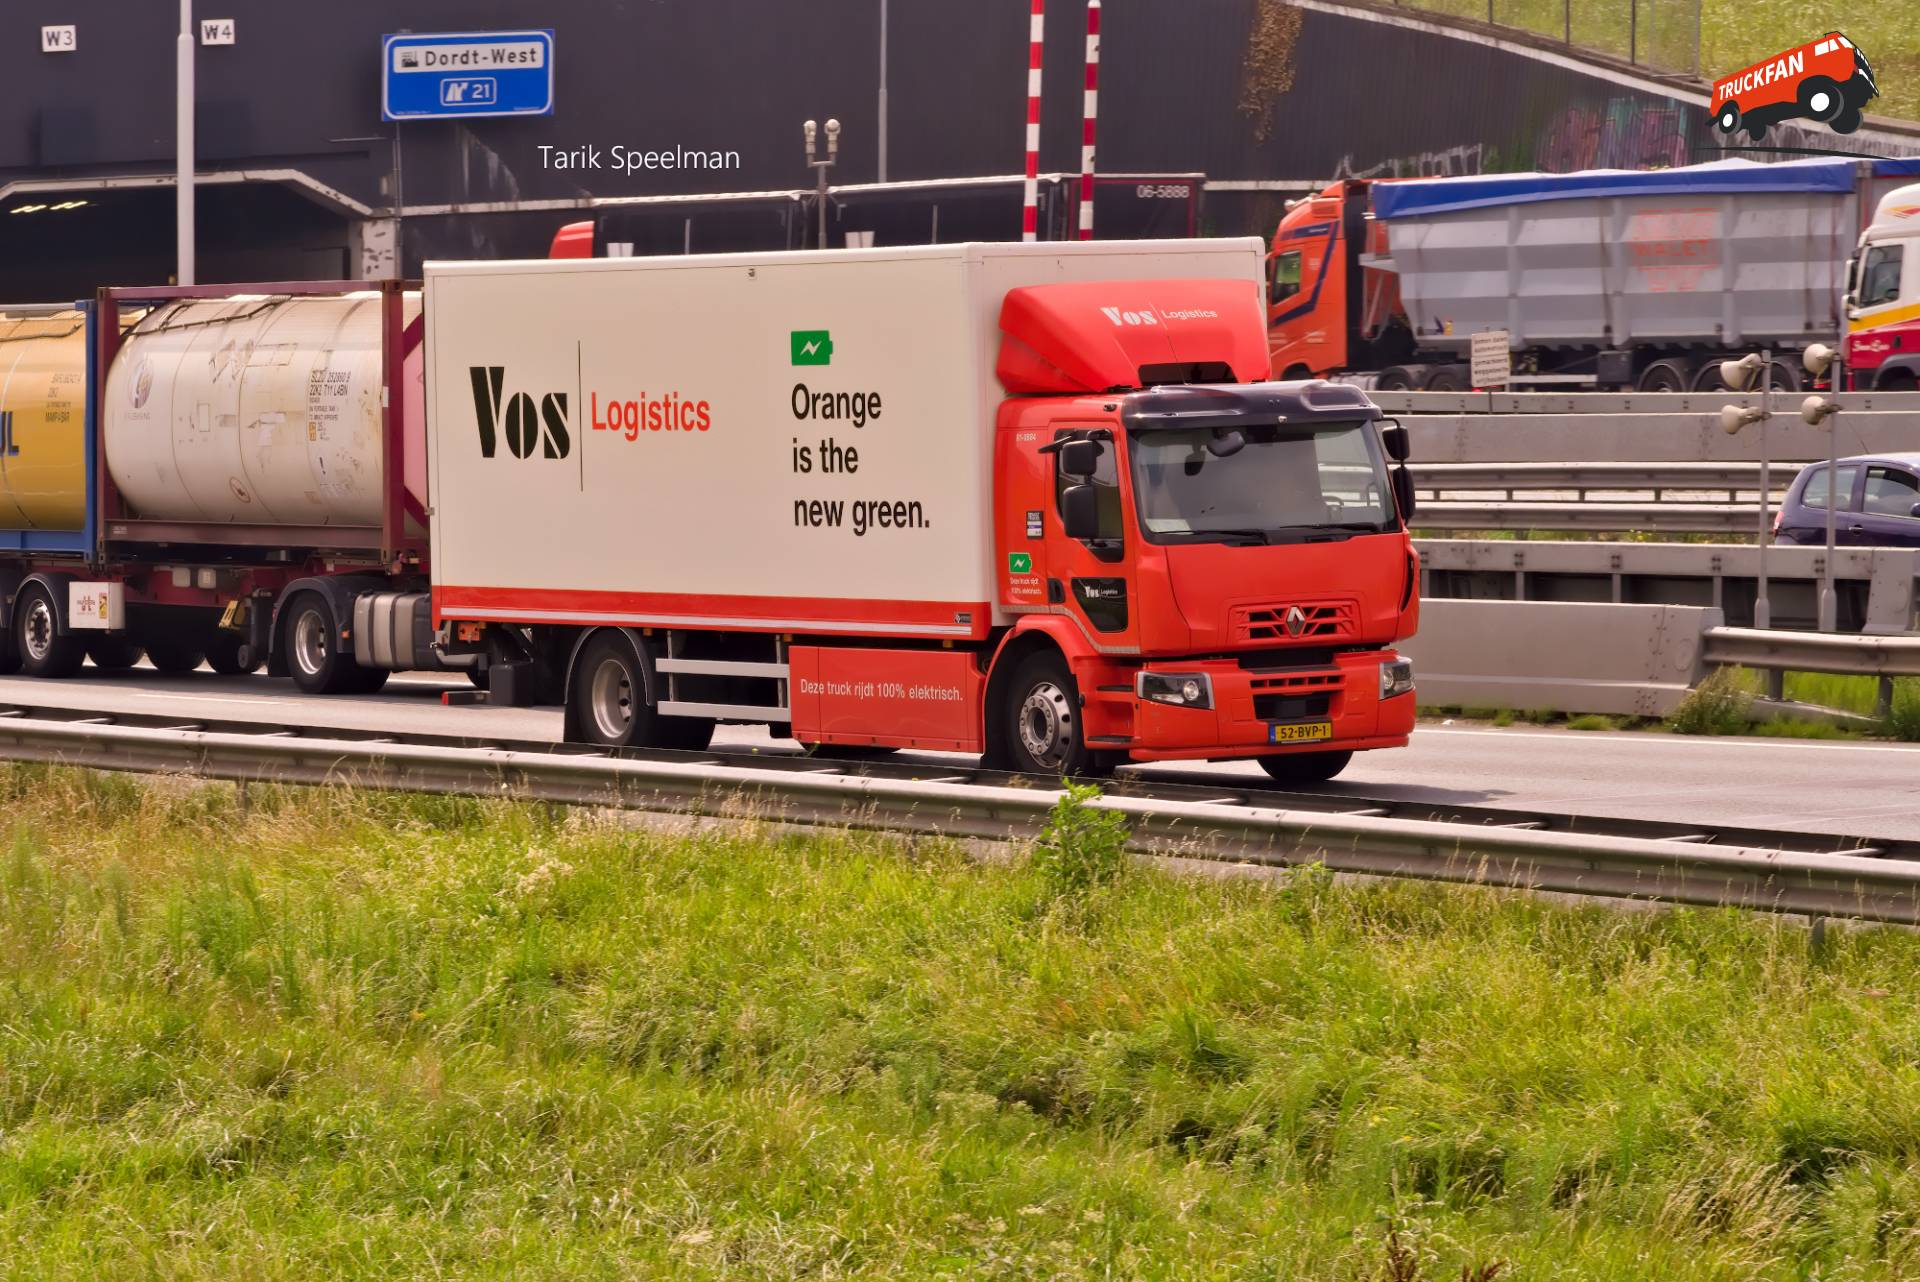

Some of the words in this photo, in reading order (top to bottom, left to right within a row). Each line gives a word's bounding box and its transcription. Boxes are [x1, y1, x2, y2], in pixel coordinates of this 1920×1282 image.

[425, 48, 537, 66] Dordt-West
[472, 84, 490, 98] 21
[1101, 306, 1158, 327] Vos
[1161, 310, 1218, 320] Logistics
[469, 366, 570, 459] Vos
[592, 391, 711, 441] Logistics
[792, 383, 882, 428] Orange
[793, 438, 812, 473] is
[819, 438, 859, 473] the
[793, 499, 844, 528] new
[852, 500, 930, 536] green.
[800, 679, 825, 694] Deze
[827, 682, 852, 695] truck
[854, 683, 875, 699] rijdt
[877, 683, 905, 698] 100%
[908, 685, 963, 701] elektrisch.
[1280, 725, 1326, 739] 52-BVP-1
